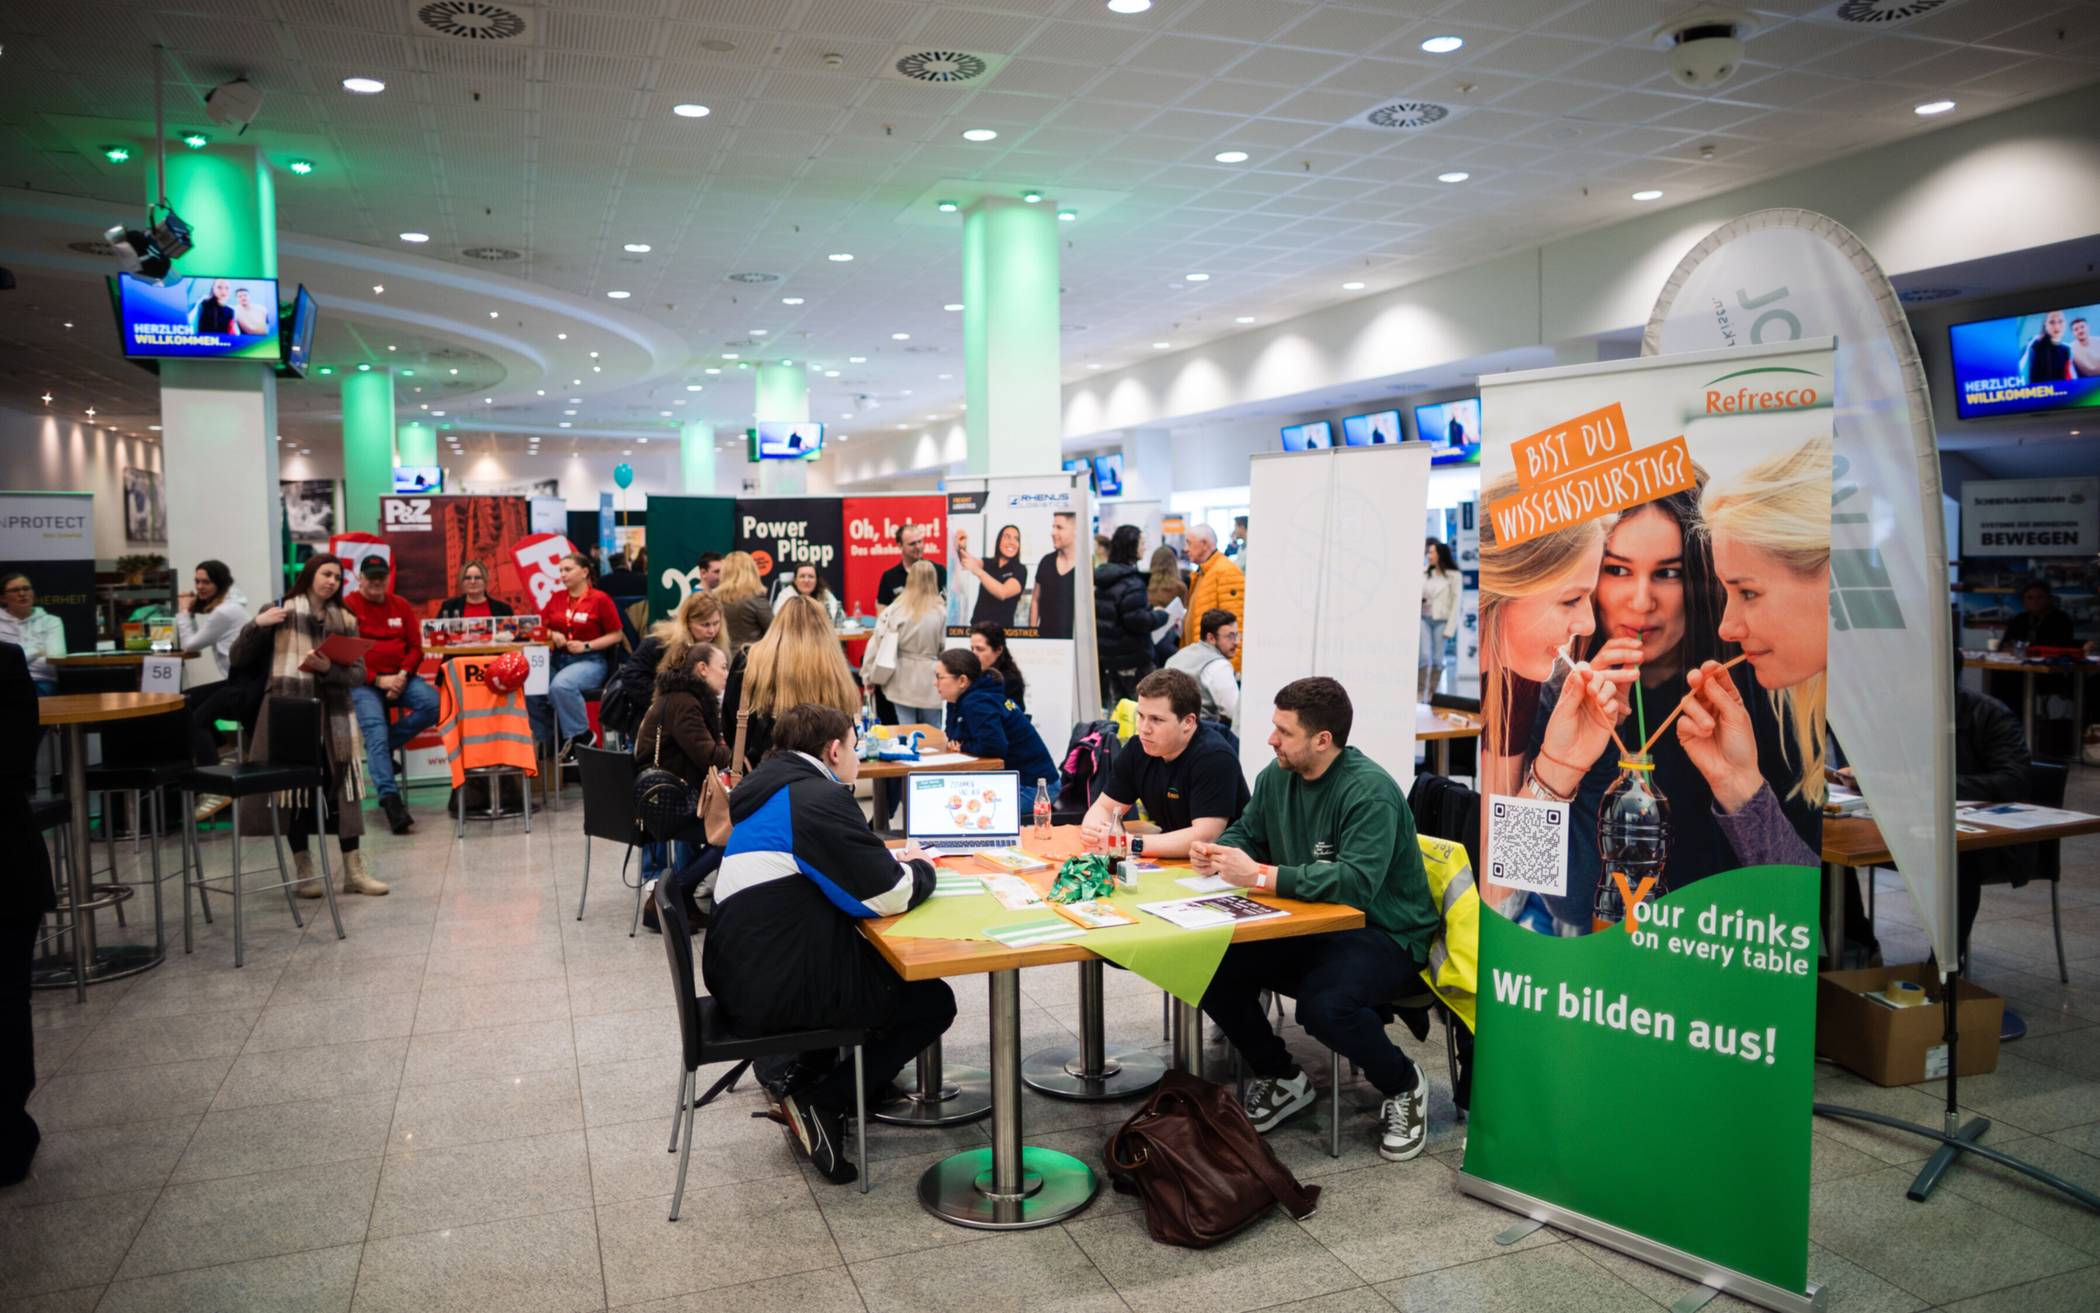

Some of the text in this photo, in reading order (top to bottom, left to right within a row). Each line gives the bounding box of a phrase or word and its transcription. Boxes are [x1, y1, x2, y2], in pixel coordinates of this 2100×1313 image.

[133, 323, 194, 334] HERZLICH
[134, 335, 232, 347] WILLKOMMEN...
[1965, 375, 2026, 392] HERZLICH
[1966, 385, 2068, 405] WILLKOMMEN...
[1705, 387, 1817, 416] Refresco
[1525, 416, 1616, 478] BIST DU
[1497, 445, 1686, 542] WISSENSDURSTIG?
[385, 499, 432, 524] P&Z
[743, 516, 807, 539] Power
[849, 517, 940, 542] Oh, leer!
[1981, 531, 2079, 546] BEWEGEN
[777, 539, 834, 566] Plöpp
[850, 544, 867, 556] Das
[152, 665, 172, 680] 58
[464, 664, 491, 682] P&
[531, 656, 545, 668] 59
[1612, 871, 1811, 950] Your drinks
[1631, 930, 1809, 976] on every table
[1493, 968, 1778, 1065] Wir bilden aus!
